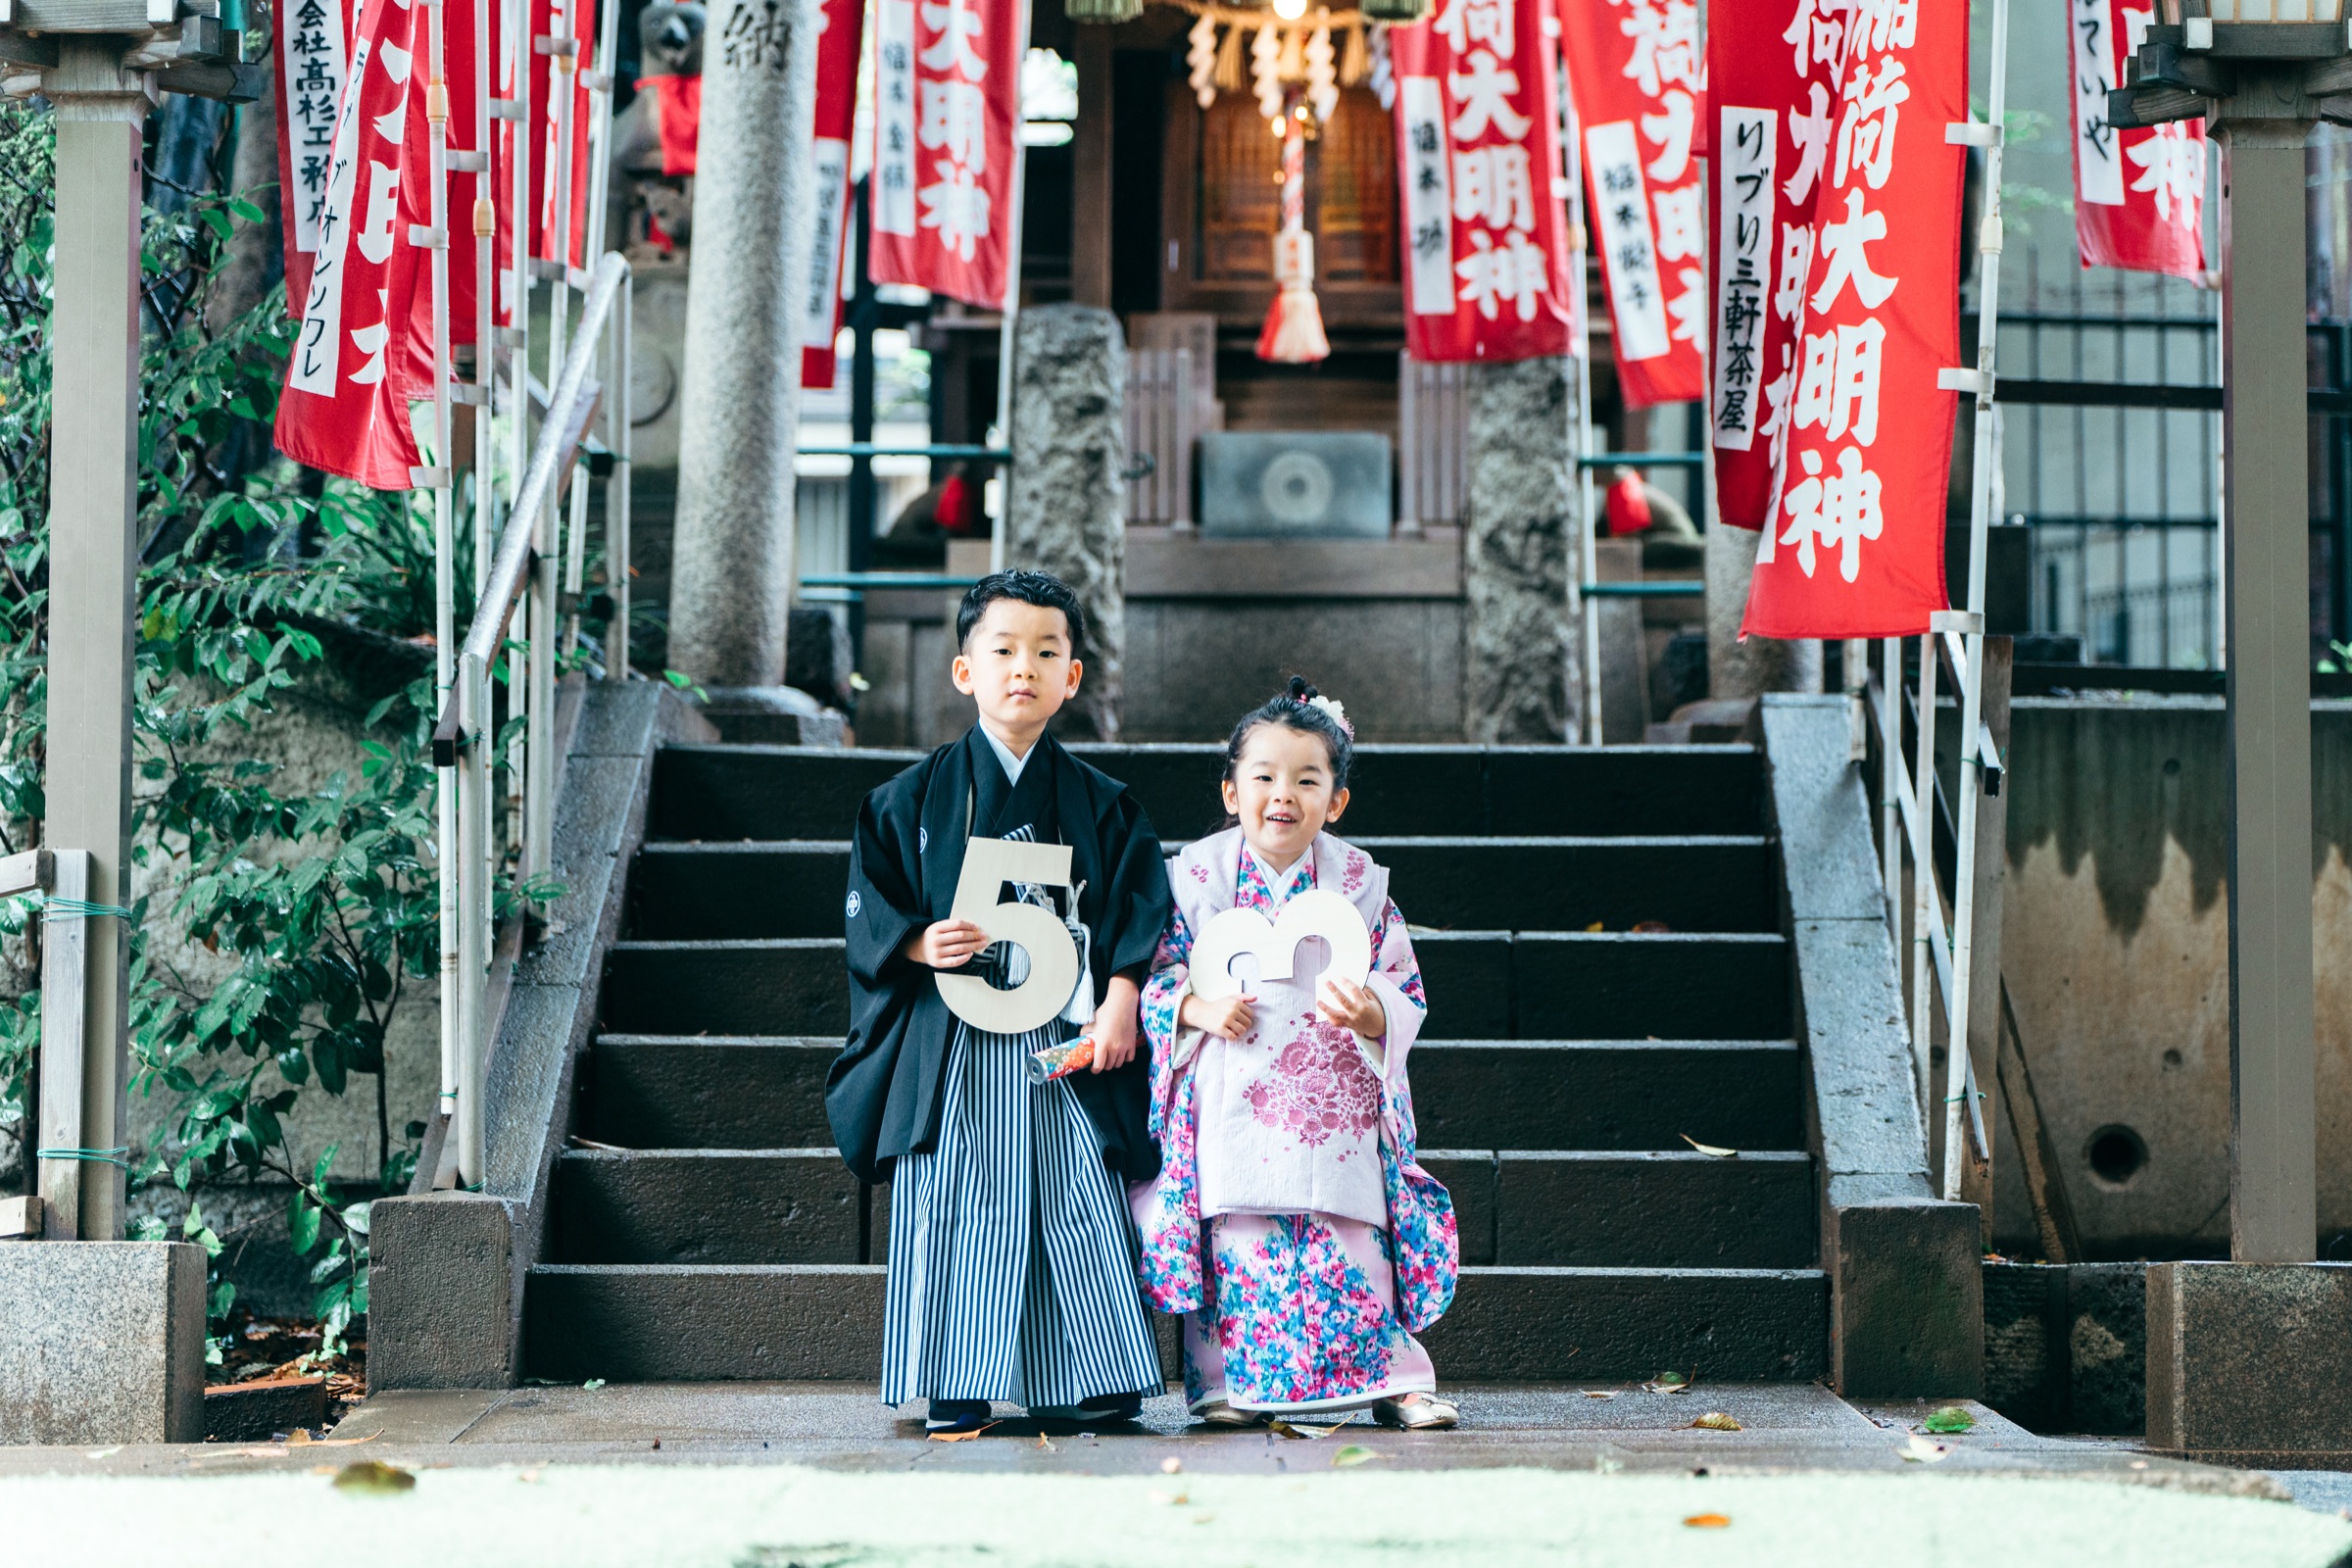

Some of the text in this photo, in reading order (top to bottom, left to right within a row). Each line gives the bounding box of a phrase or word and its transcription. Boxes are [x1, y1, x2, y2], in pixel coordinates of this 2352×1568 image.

[2080, 0, 2112, 163] ていや
[935, 836, 1080, 1034] 5
[1190, 889, 1372, 1024] 3
